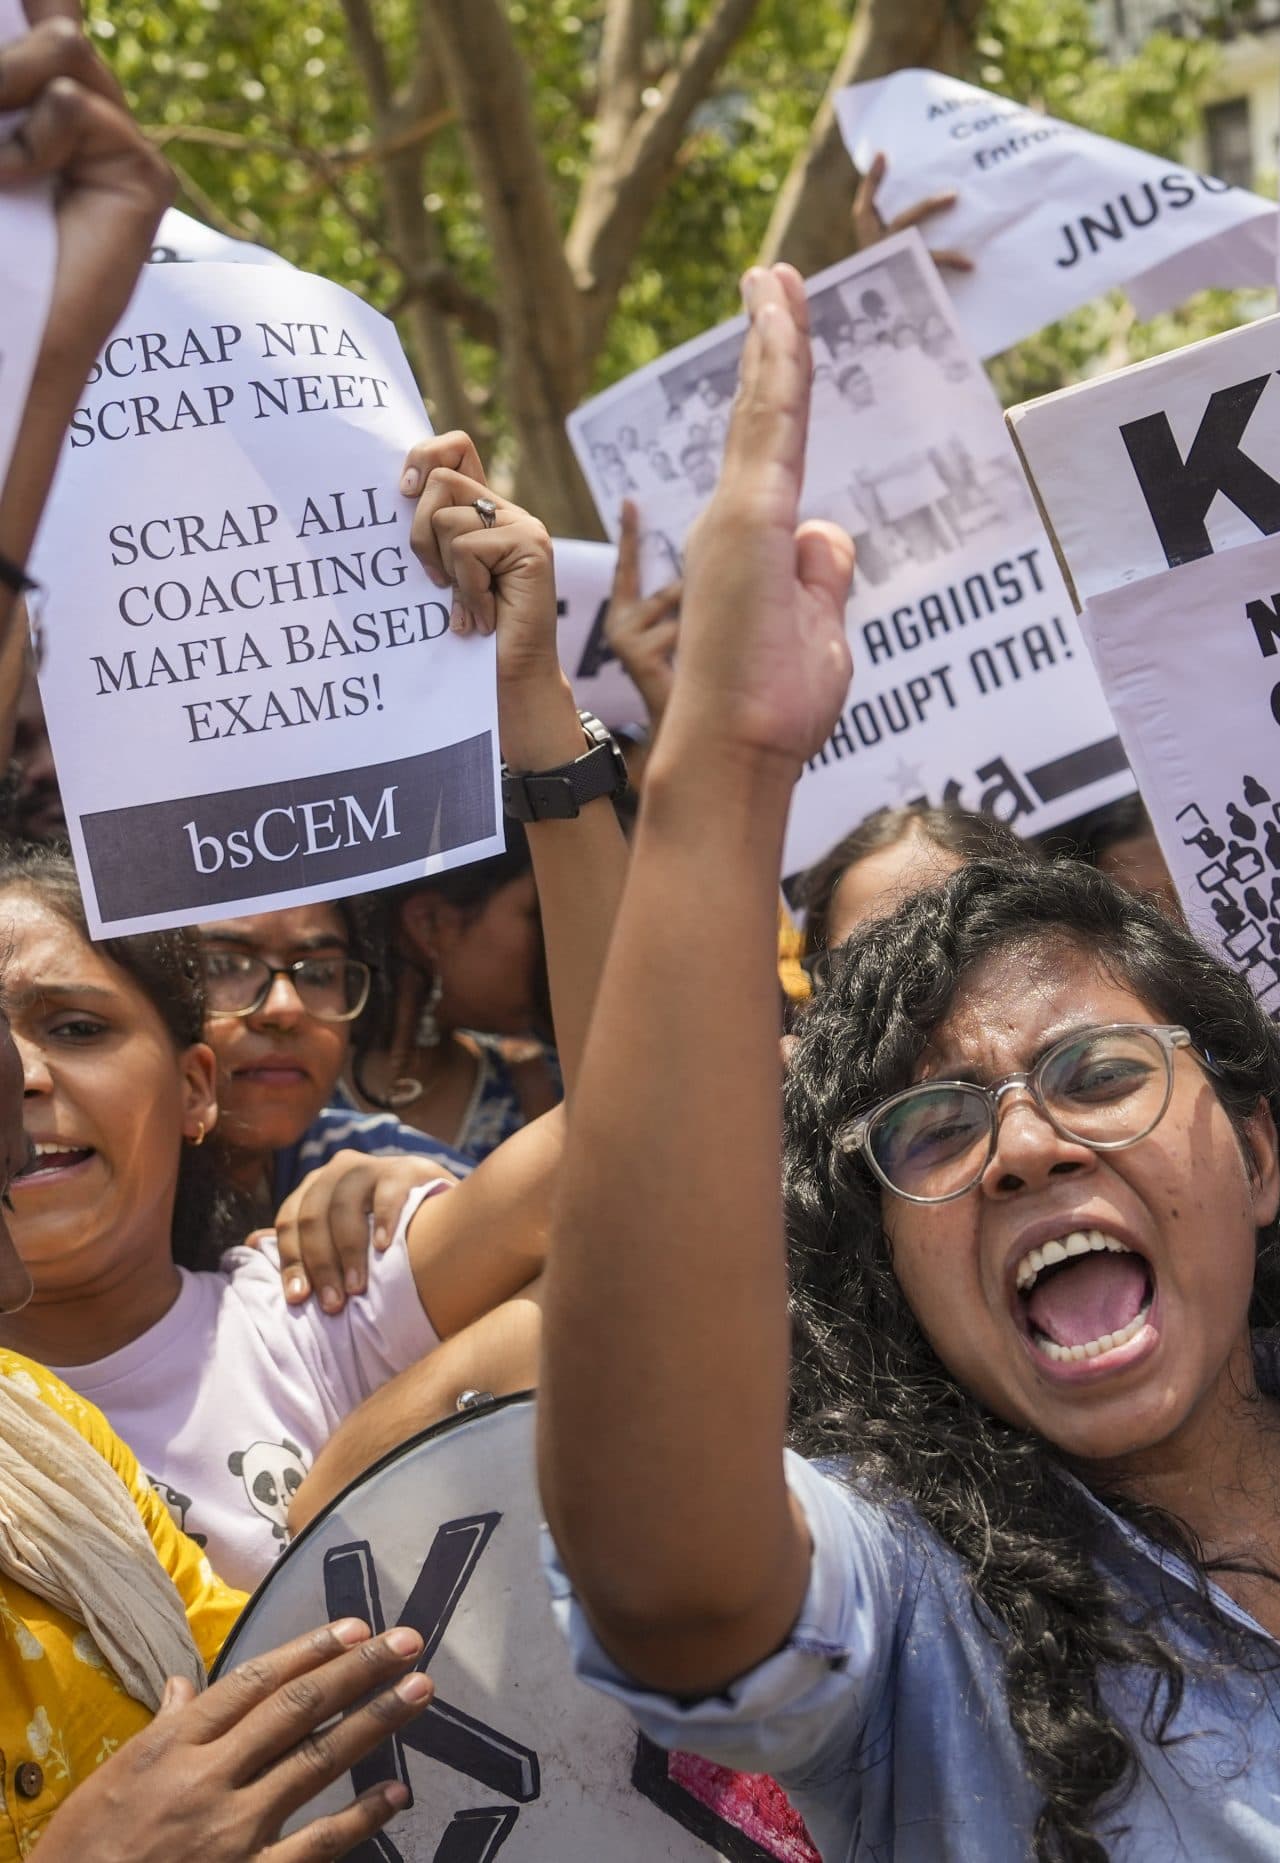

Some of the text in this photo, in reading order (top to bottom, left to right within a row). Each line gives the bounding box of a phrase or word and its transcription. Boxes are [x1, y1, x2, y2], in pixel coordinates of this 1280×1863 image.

[256, 322, 367, 360] NTA
[70, 374, 390, 448] SCRAP NEET
[109, 487, 398, 566] SCRAP ALL
[118, 545, 409, 629] COACHING
[862, 549, 1044, 666] AGAINST
[90, 601, 451, 695] MAFIA BASED
[969, 617, 1072, 694] NTA!
[183, 673, 383, 744] EXAMS!
[183, 786, 400, 875] bsCEM
